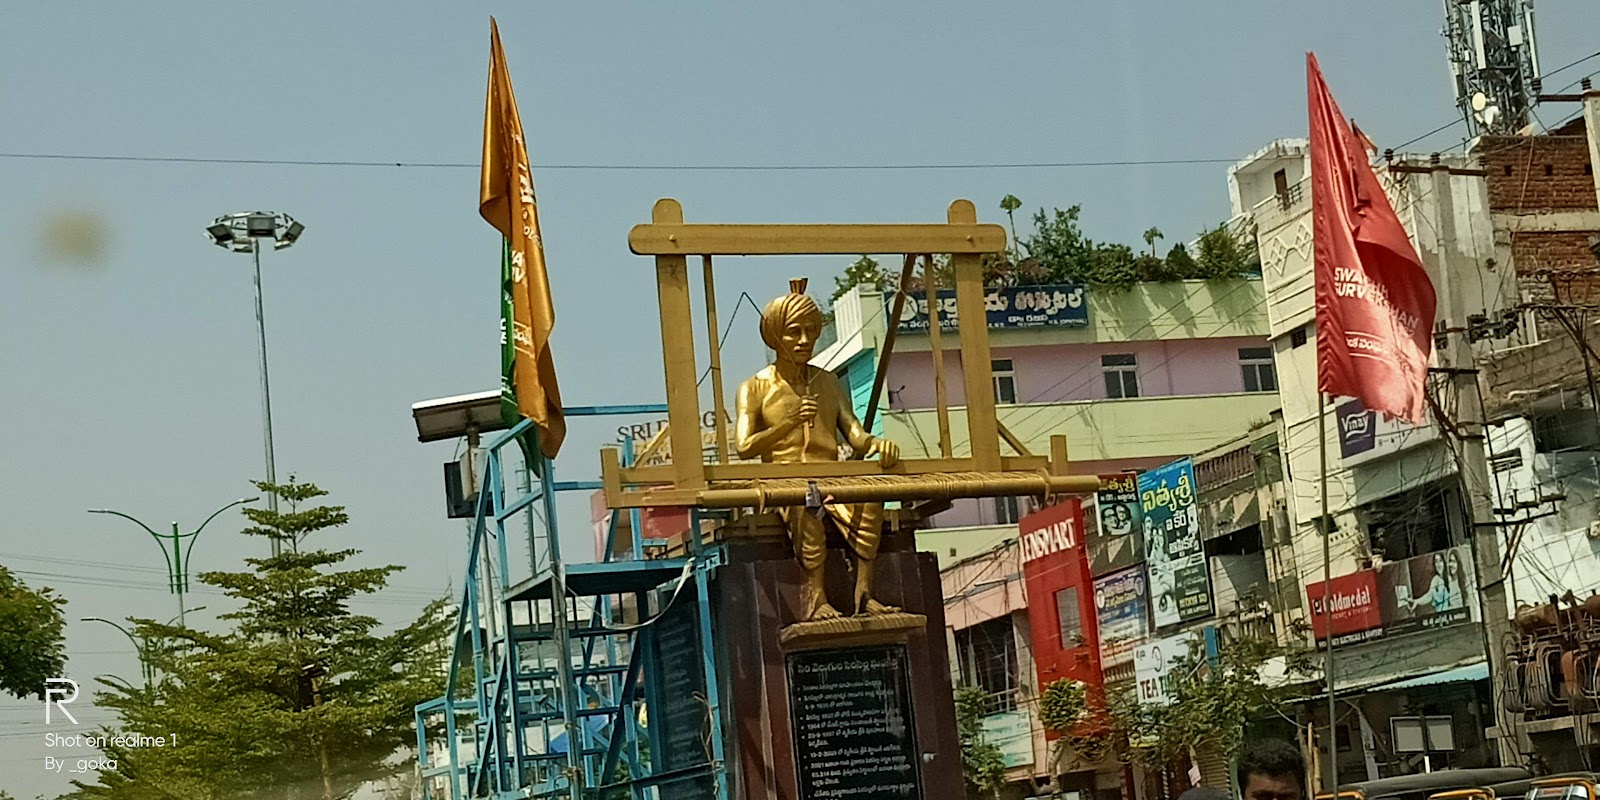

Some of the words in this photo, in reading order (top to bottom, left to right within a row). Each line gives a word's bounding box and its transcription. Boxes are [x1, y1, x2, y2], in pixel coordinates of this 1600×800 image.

[617, 422, 653, 443] SRI
[1341, 412, 1369, 436] Vinay
[1142, 468, 1194, 513] నిత్యశ్రీ
[1140, 678, 1159, 700] TEA
